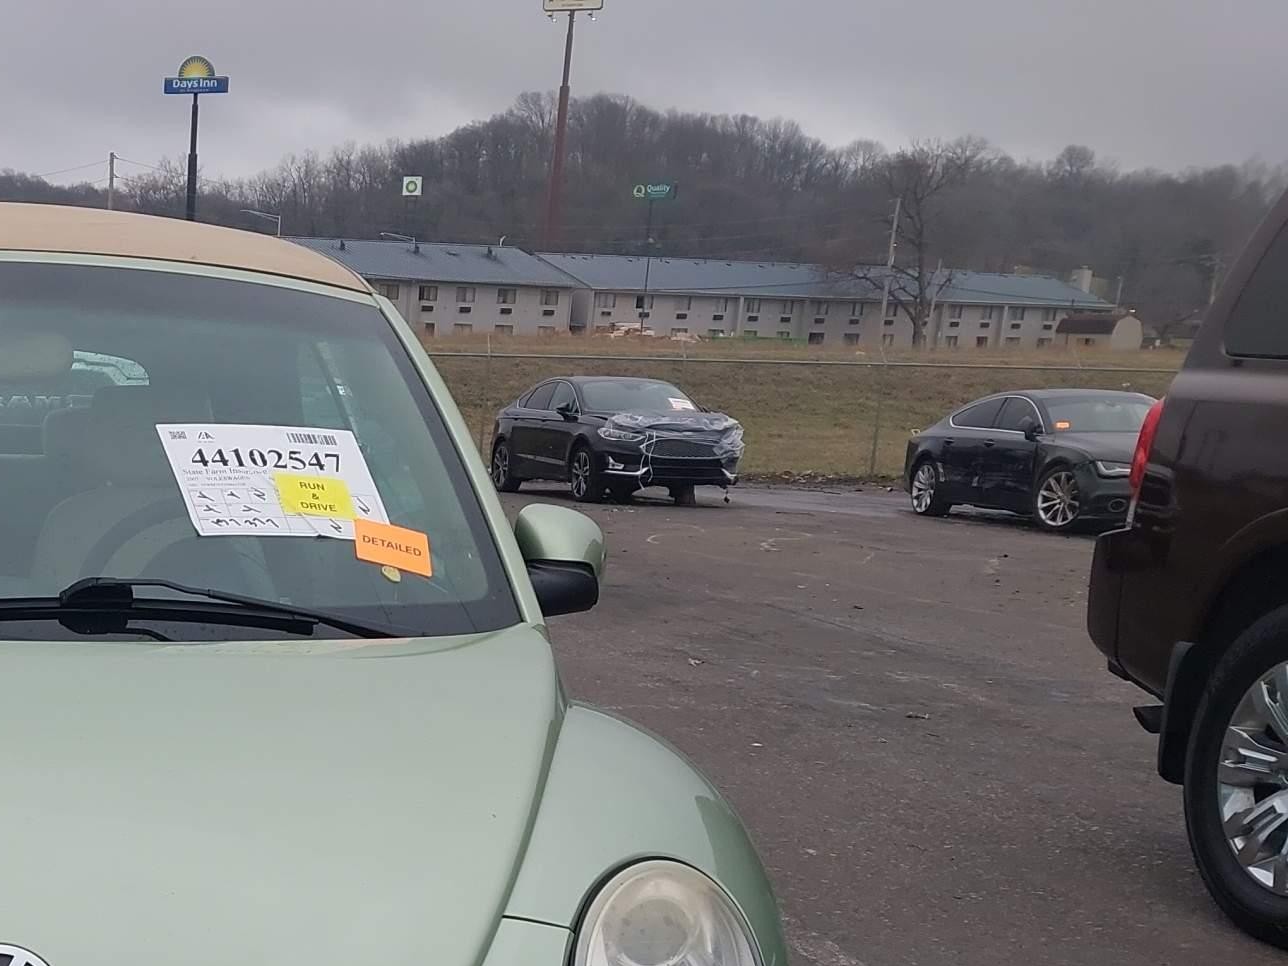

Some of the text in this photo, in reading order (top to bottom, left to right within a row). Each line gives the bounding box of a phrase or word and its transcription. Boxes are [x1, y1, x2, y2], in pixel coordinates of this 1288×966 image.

[172, 79, 218, 88] Days Inn
[191, 448, 341, 473] 44102547
[299, 481, 325, 491] RUN
[300, 501, 337, 512] DRIVE
[362, 534, 422, 557] DETAILED
